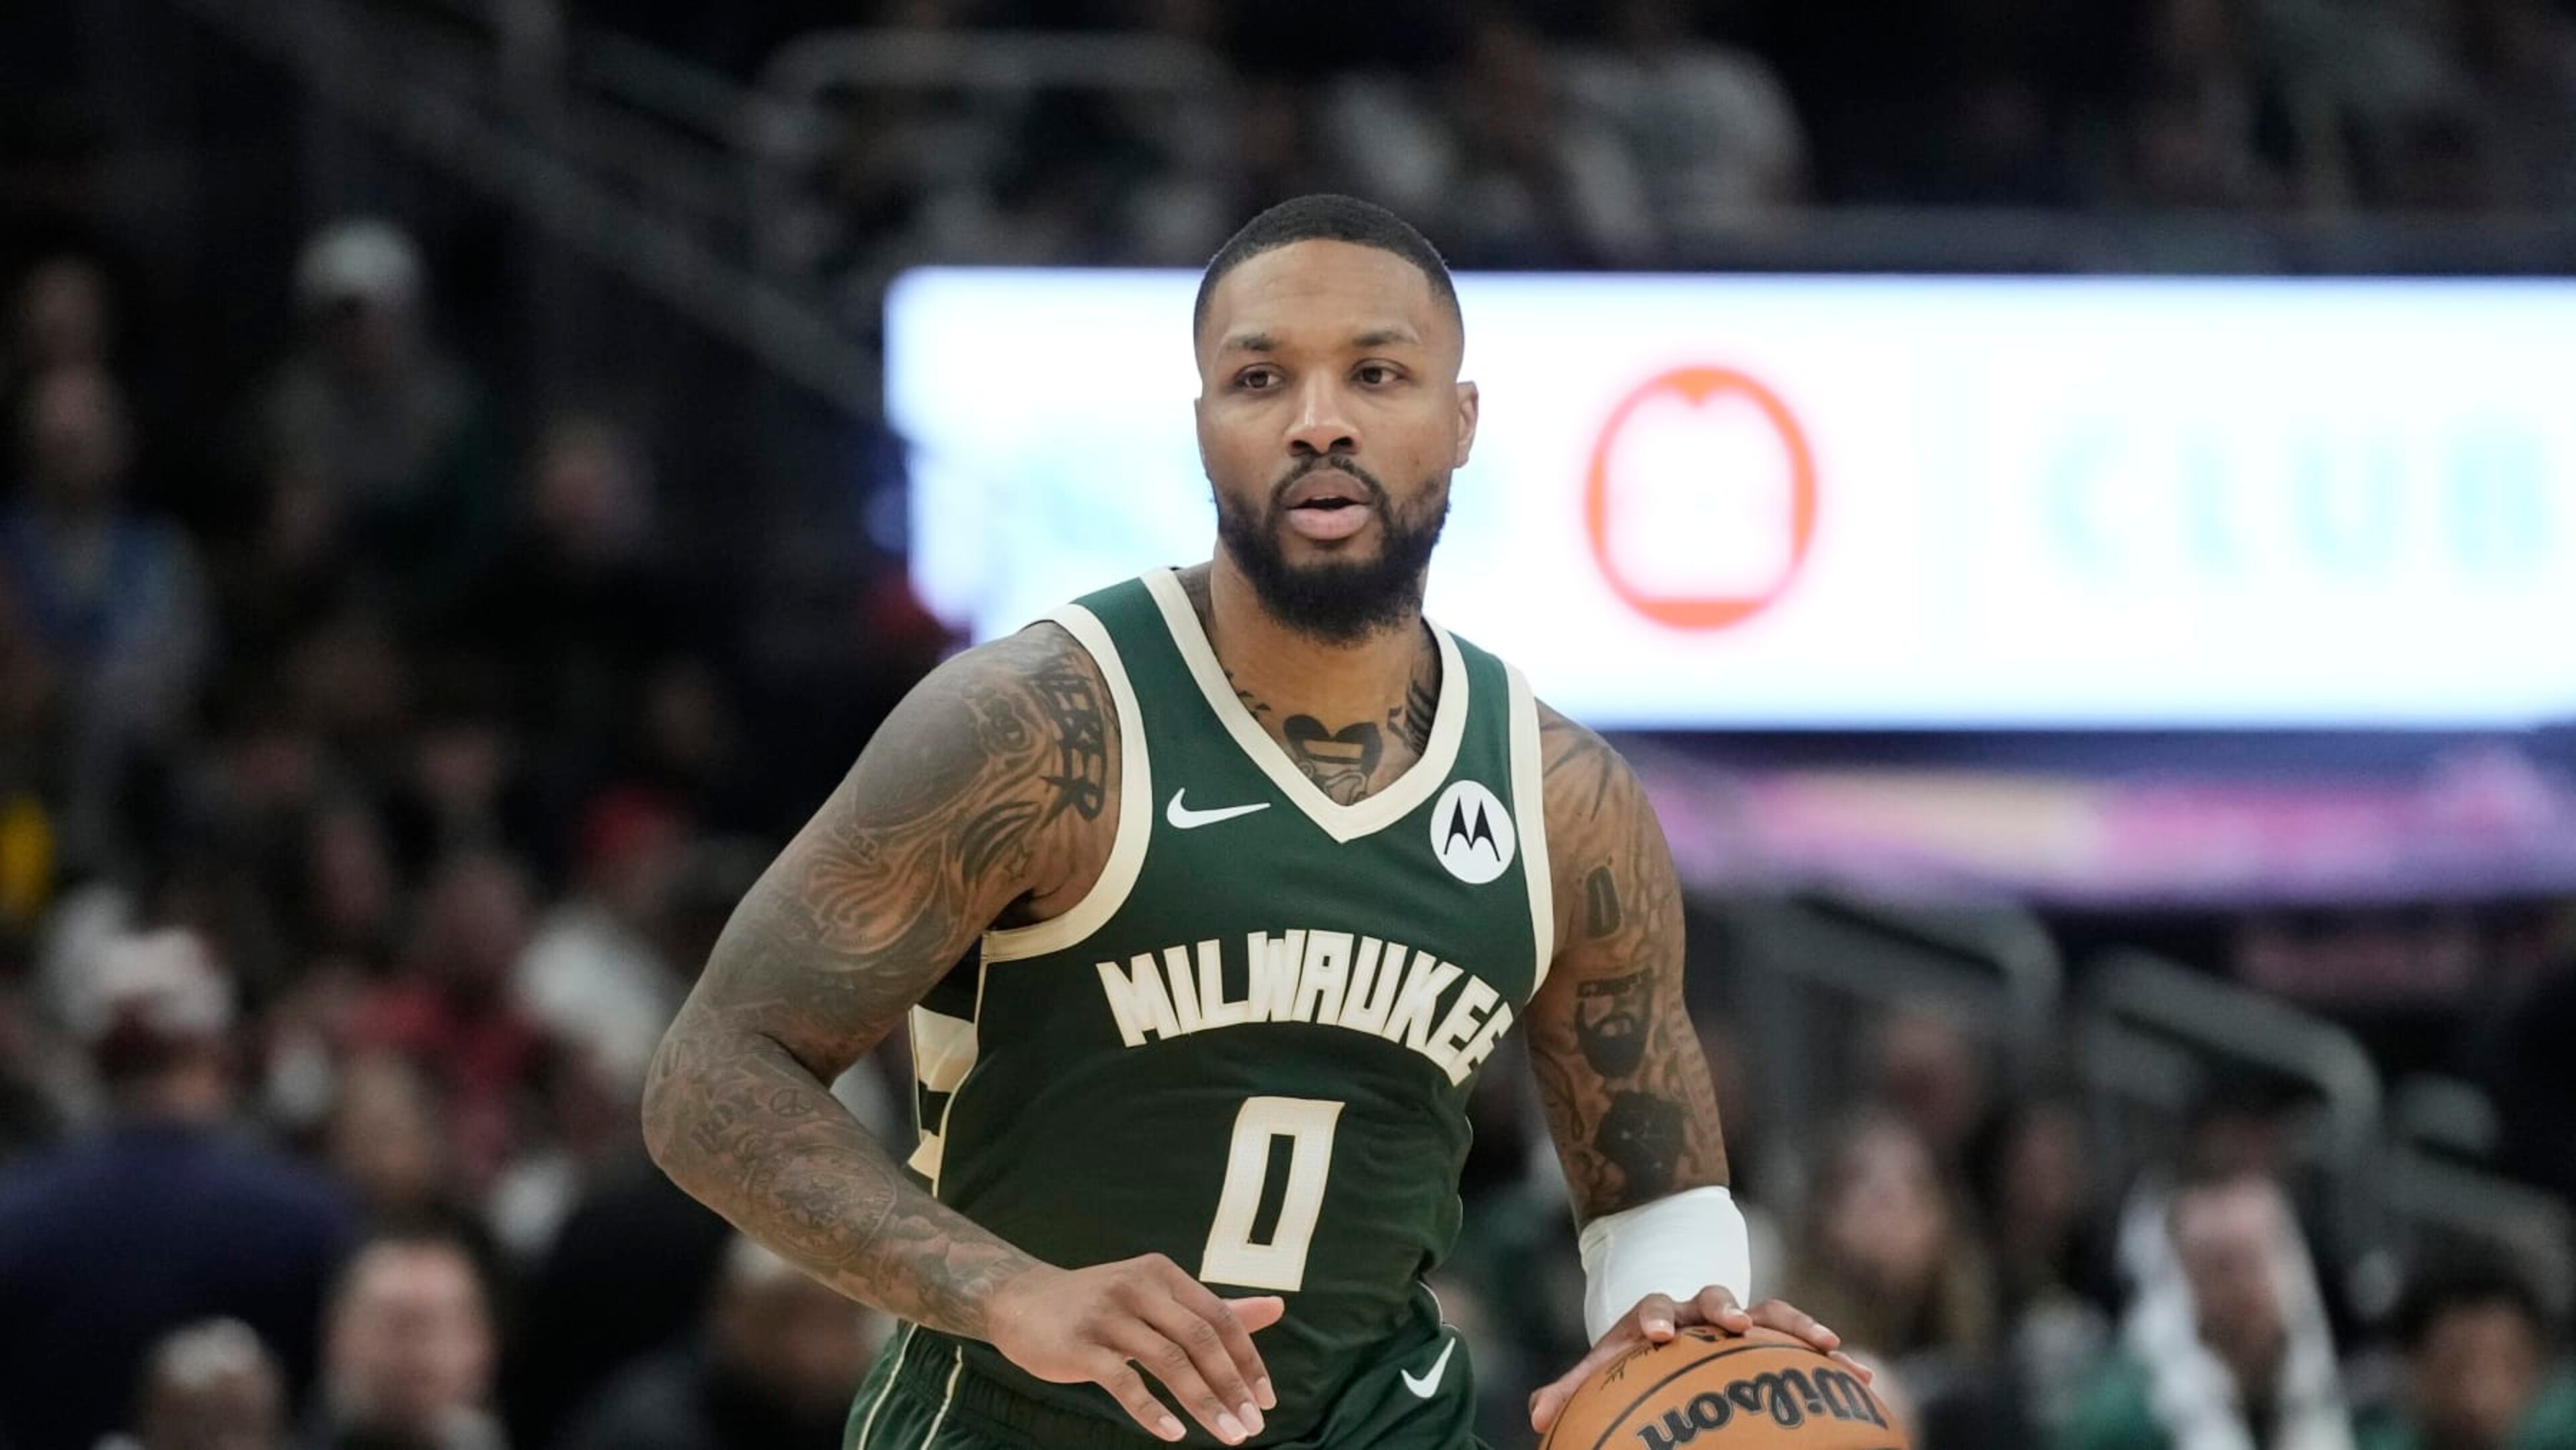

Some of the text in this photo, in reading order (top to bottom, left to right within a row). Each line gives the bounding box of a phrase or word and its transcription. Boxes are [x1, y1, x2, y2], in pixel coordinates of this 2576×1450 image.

[1095, 929, 1514, 1088] MILWAUKEE
[1199, 1095, 1346, 1292] 0
[1636, 1366, 1889, 1450] Wilson
